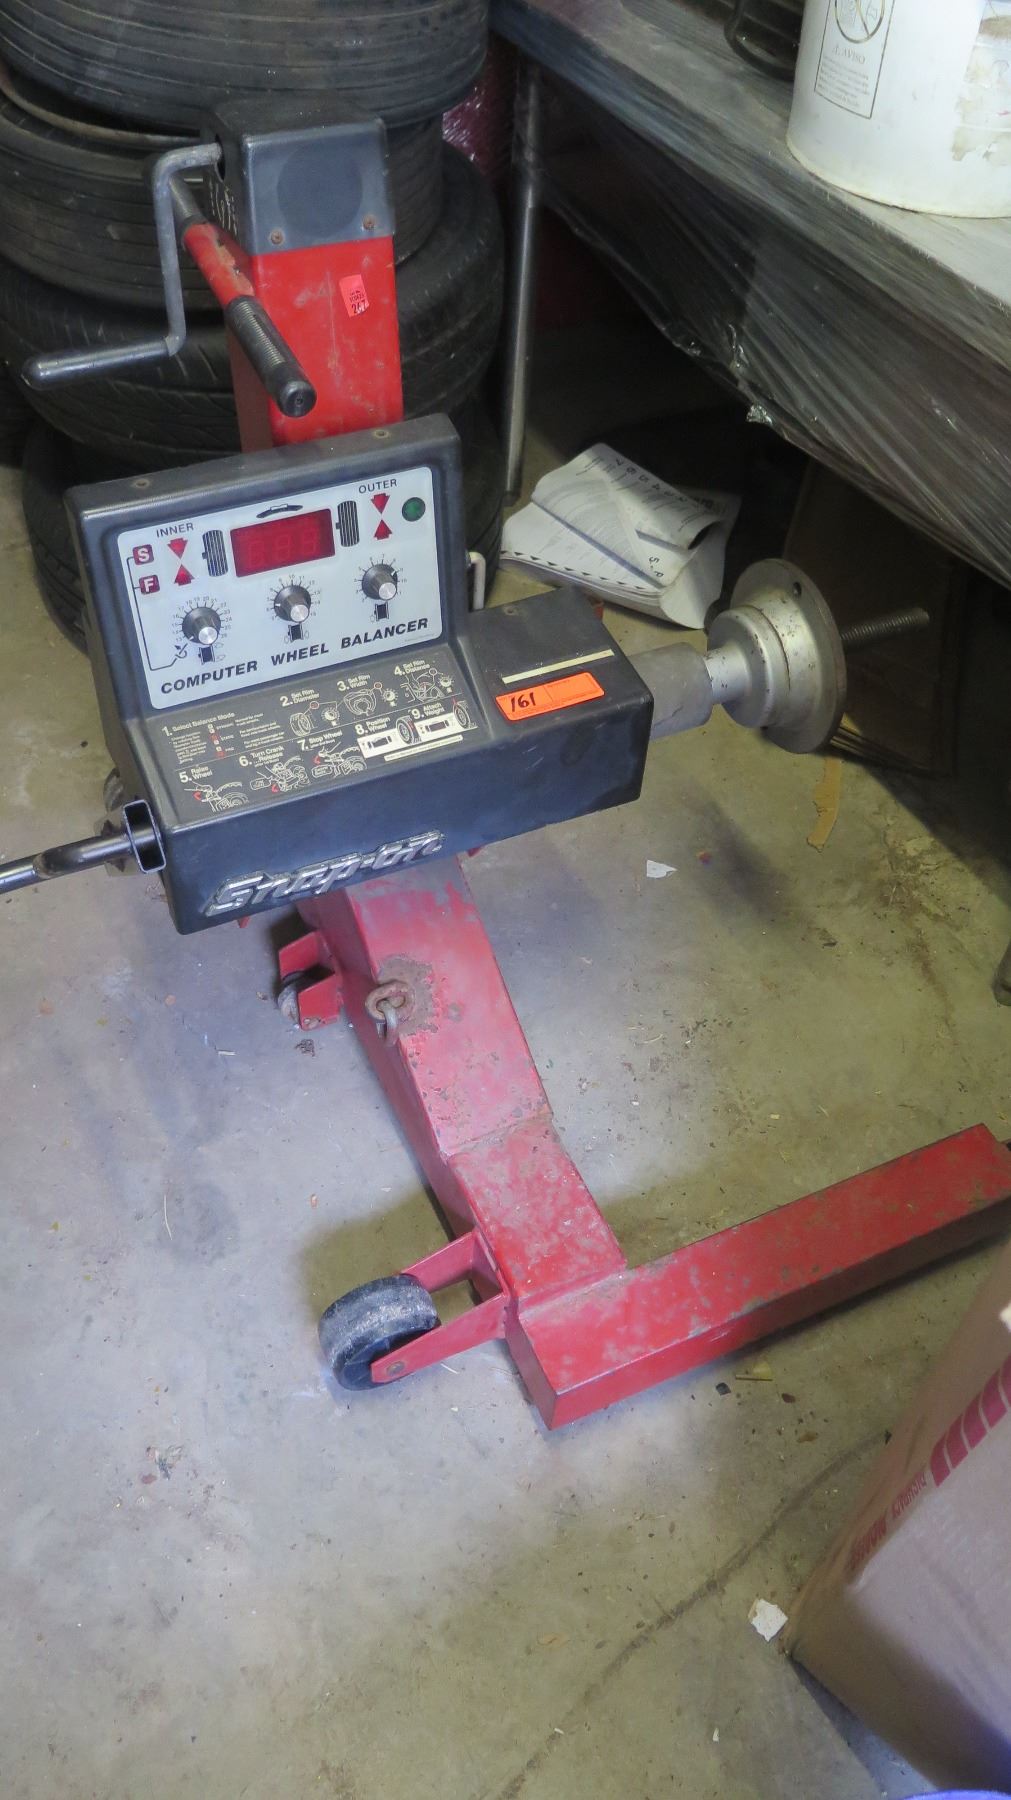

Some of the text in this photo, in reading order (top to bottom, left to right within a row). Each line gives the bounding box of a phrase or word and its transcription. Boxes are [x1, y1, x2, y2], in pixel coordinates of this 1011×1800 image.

[358, 478, 397, 494] OUTER
[156, 522, 194, 538] INNER
[137, 547, 150, 563] S
[143, 577, 154, 593] F
[161, 617, 429, 694] COMPUTER WHEEL BALANCER
[394, 666, 405, 676] 4.
[413, 659, 426, 667] Rim
[405, 663, 431, 674] Distance
[336, 681, 350, 692] 3.
[358, 673, 371, 681] Rim
[349, 681, 368, 689] Width
[280, 689, 314, 707] 2. Set Rim
[293, 693, 320, 704] Diameter
[511, 691, 536, 713] 161
[411, 708, 425, 720] 9.
[424, 706, 445, 717] Weight
[161, 726, 173, 737] 1.
[172, 722, 192, 732] Select
[192, 716, 217, 727] Balance
[217, 712, 236, 721] Mode
[354, 716, 391, 735] 8. Position
[367, 723, 388, 733] Wheel
[297, 740, 309, 751] 7.
[308, 734, 324, 744] Stop
[323, 730, 343, 740] Wheel
[238, 755, 253, 767] 6.
[251, 750, 266, 759] Turn
[265, 746, 285, 756] Crank
[179, 765, 209, 783] 5. Raise
[193, 770, 213, 780] Wheel
[204, 830, 445, 917] Snap-on
